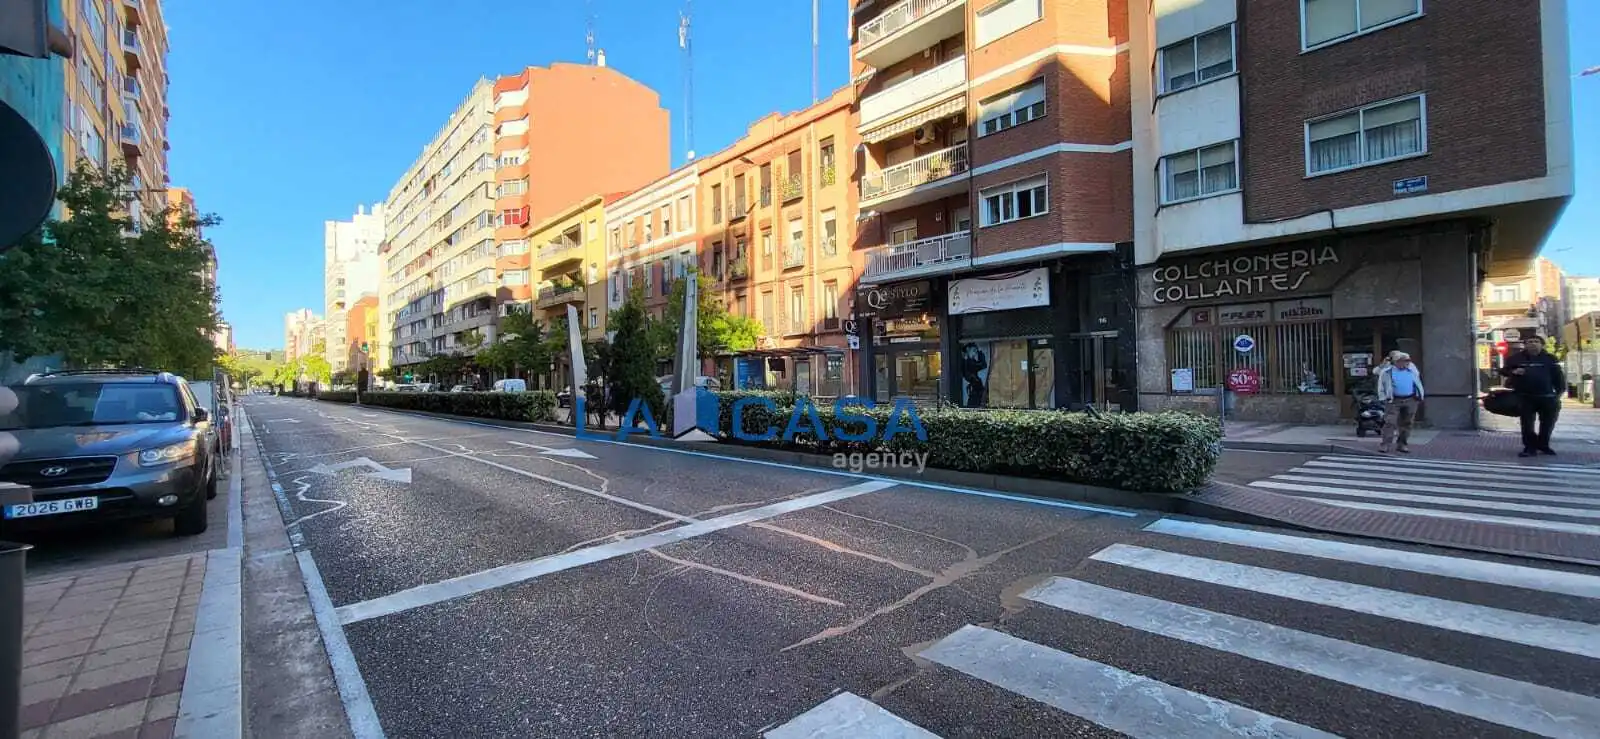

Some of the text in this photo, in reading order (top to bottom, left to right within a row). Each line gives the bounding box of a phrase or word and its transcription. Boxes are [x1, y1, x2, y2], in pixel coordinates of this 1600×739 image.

[1152, 246, 1339, 283] COLCHONERIA
[1153, 271, 1310, 302] COLLANTES
[1230, 373, 1258, 386] 50%
[15, 499, 94, 516] 2026 GWB
